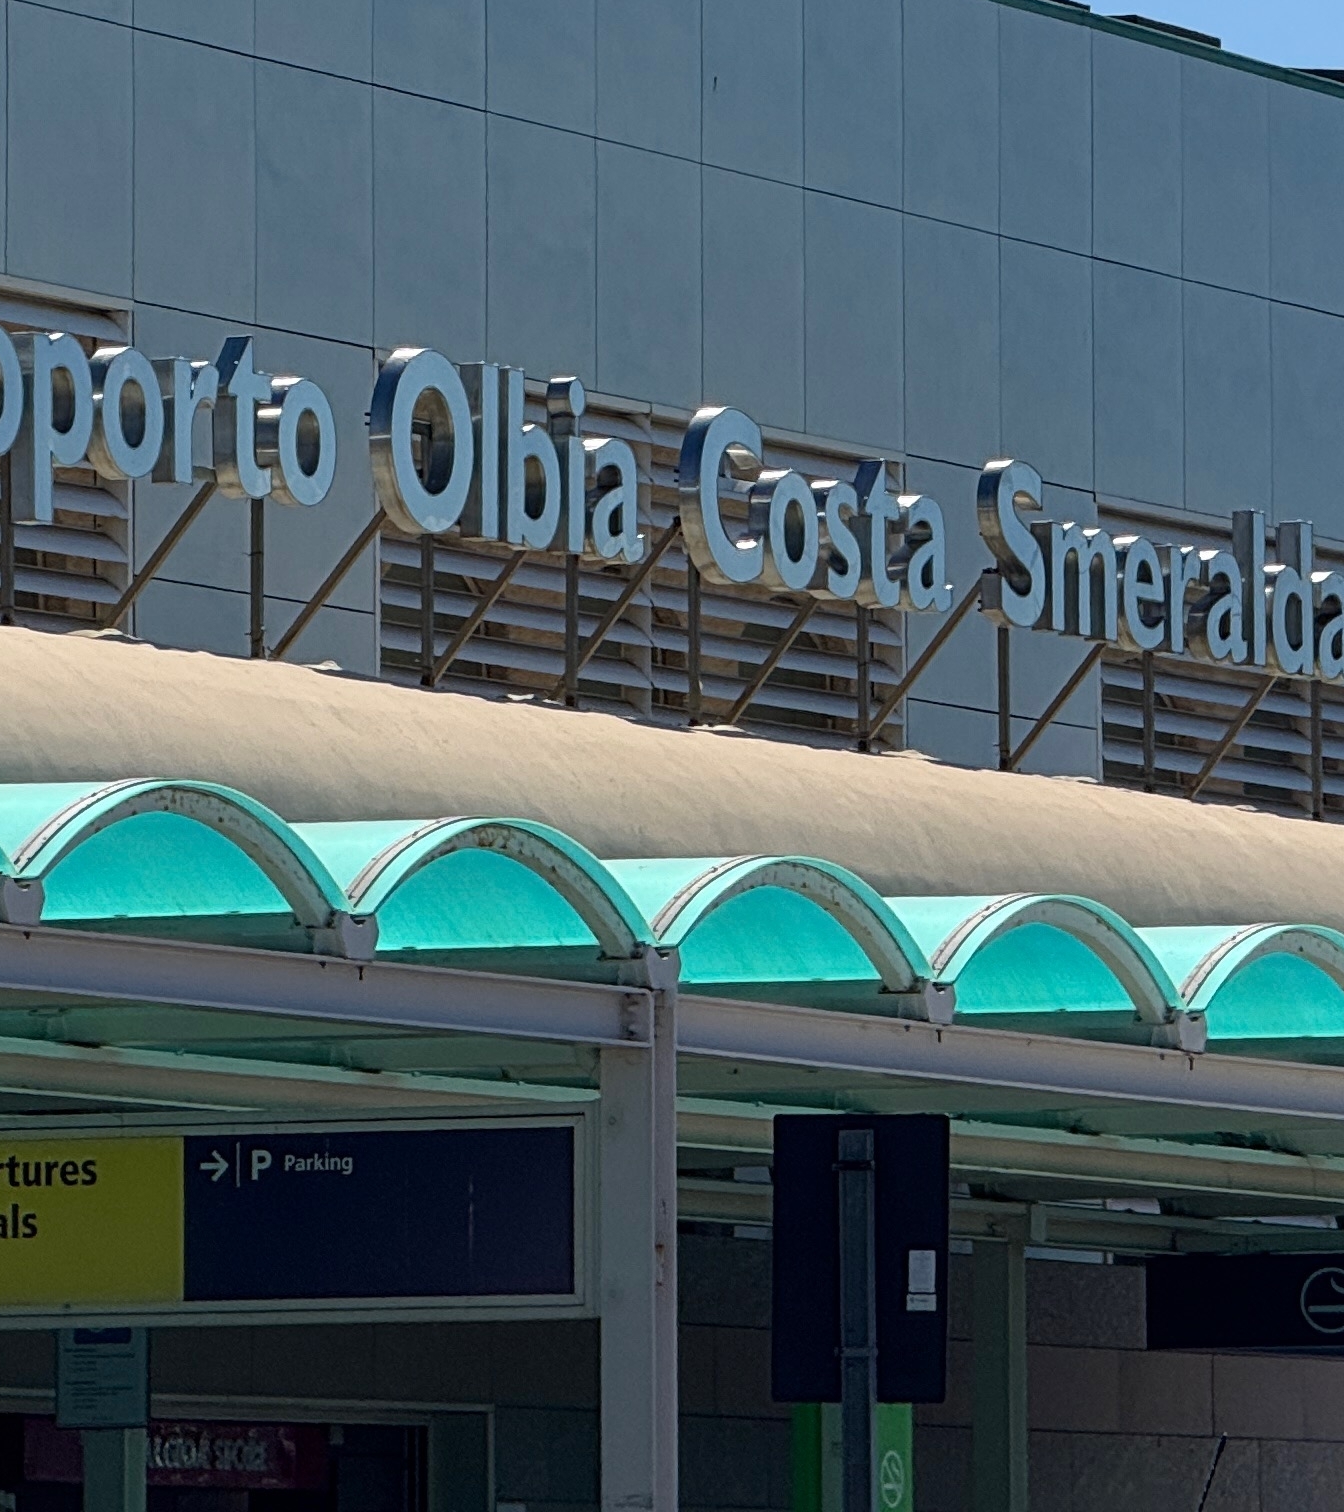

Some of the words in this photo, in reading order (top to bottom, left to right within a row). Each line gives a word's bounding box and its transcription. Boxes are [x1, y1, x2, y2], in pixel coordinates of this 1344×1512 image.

[370, 346, 646, 565] Olbia
[679, 406, 954, 614] Costa
[251, 1149, 273, 1181] P
[284, 1152, 354, 1176] Parking
